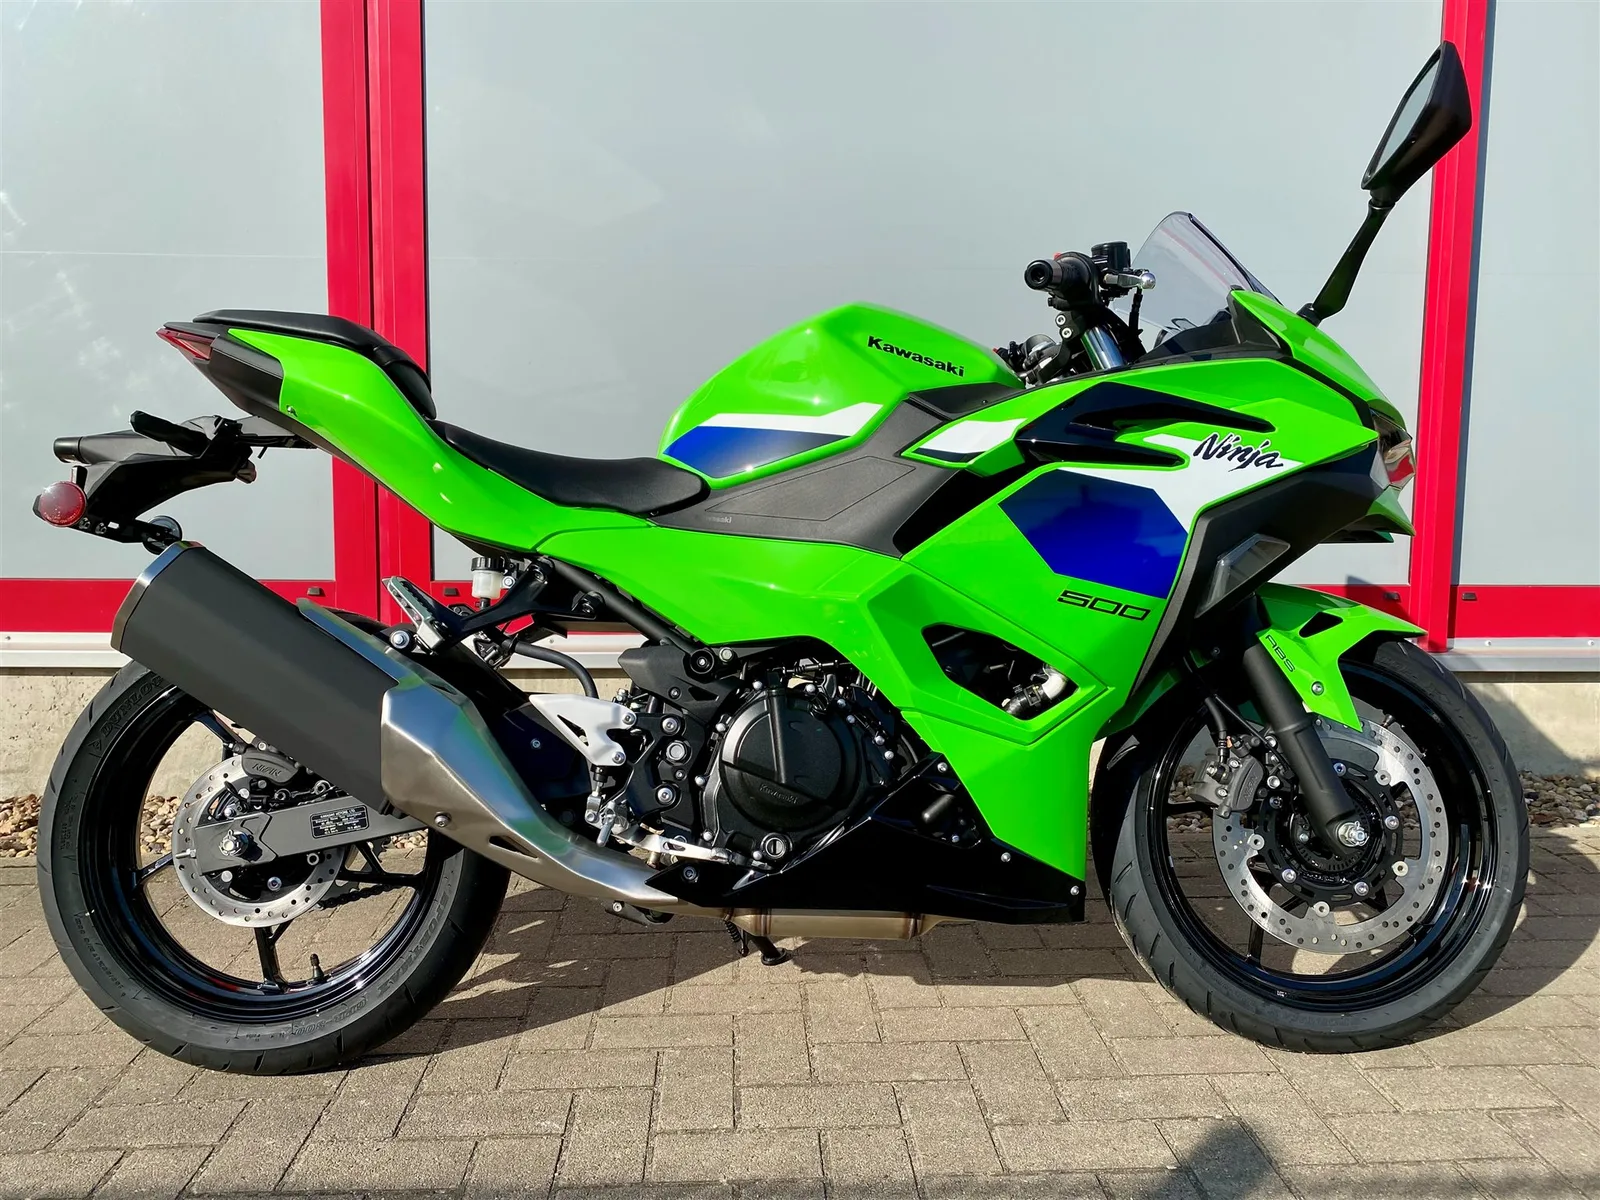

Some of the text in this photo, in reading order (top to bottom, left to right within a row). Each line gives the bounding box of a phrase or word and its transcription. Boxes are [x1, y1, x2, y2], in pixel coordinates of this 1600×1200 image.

[867, 335, 965, 377] Kawasaki
[1193, 433, 1284, 472] Ninja
[1057, 590, 1151, 621] 500
[1265, 634, 1296, 673] ABS
